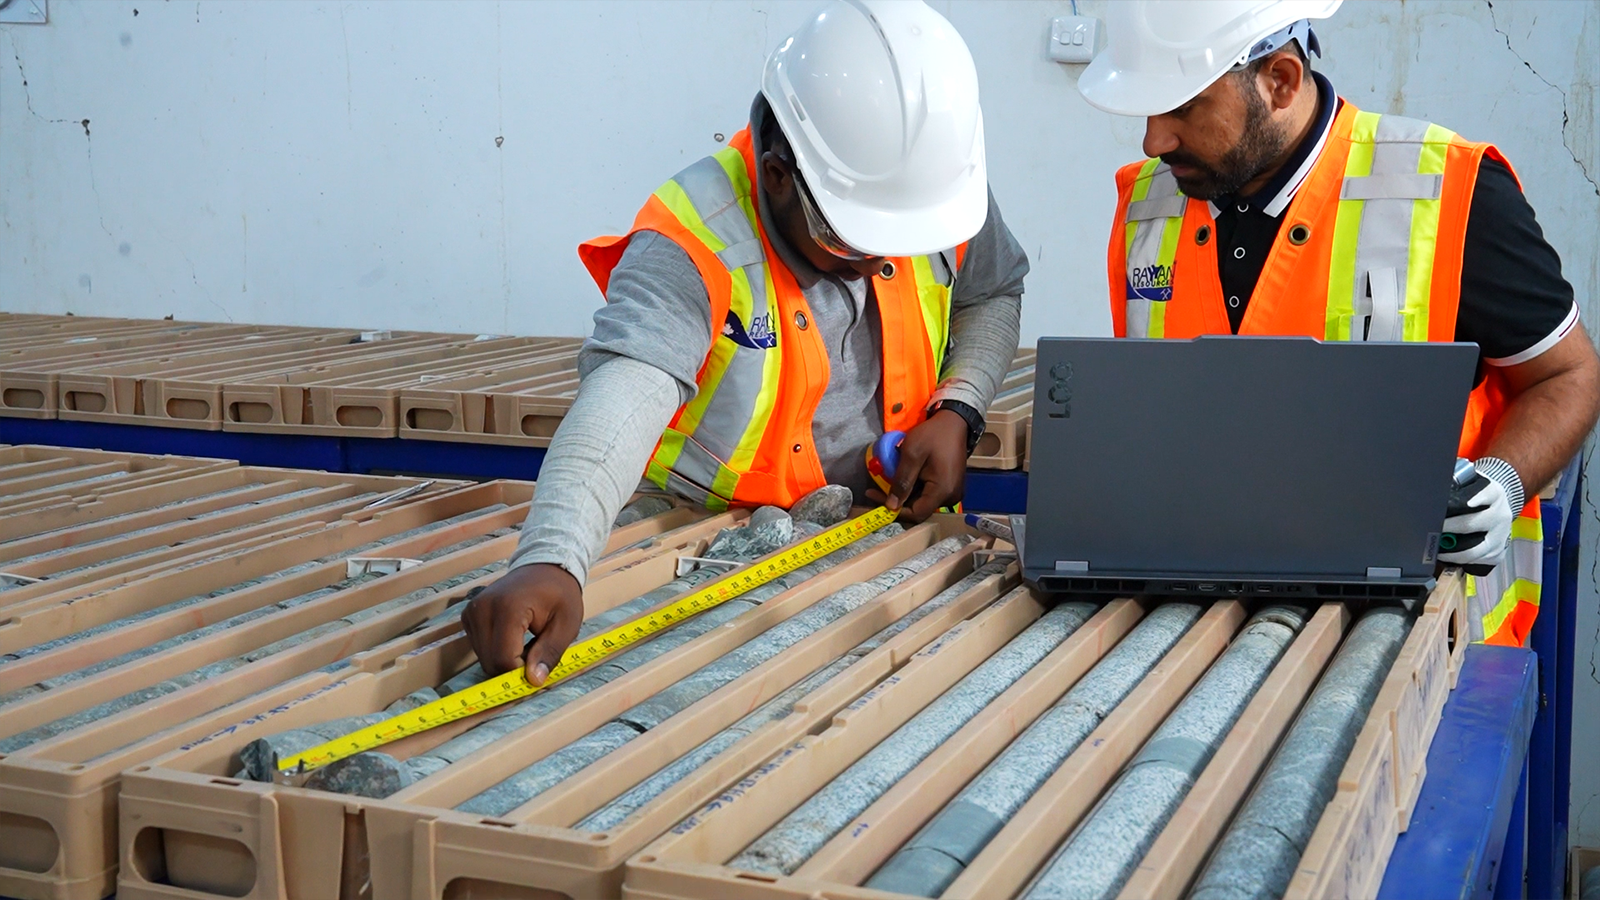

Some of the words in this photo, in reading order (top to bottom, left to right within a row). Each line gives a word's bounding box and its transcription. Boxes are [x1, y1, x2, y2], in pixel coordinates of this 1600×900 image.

[1425, 535, 1437, 561] Lenovo
[501, 681, 511, 691] 10
[571, 653, 581, 661] 14
[587, 646, 597, 654] 15
[690, 600, 700, 608] 22
[704, 593, 714, 602] 23
[731, 581, 740, 589] 25
[743, 575, 752, 583] 26
[756, 569, 764, 577] 27
[768, 563, 776, 571] 28
[780, 558, 788, 566] 29
